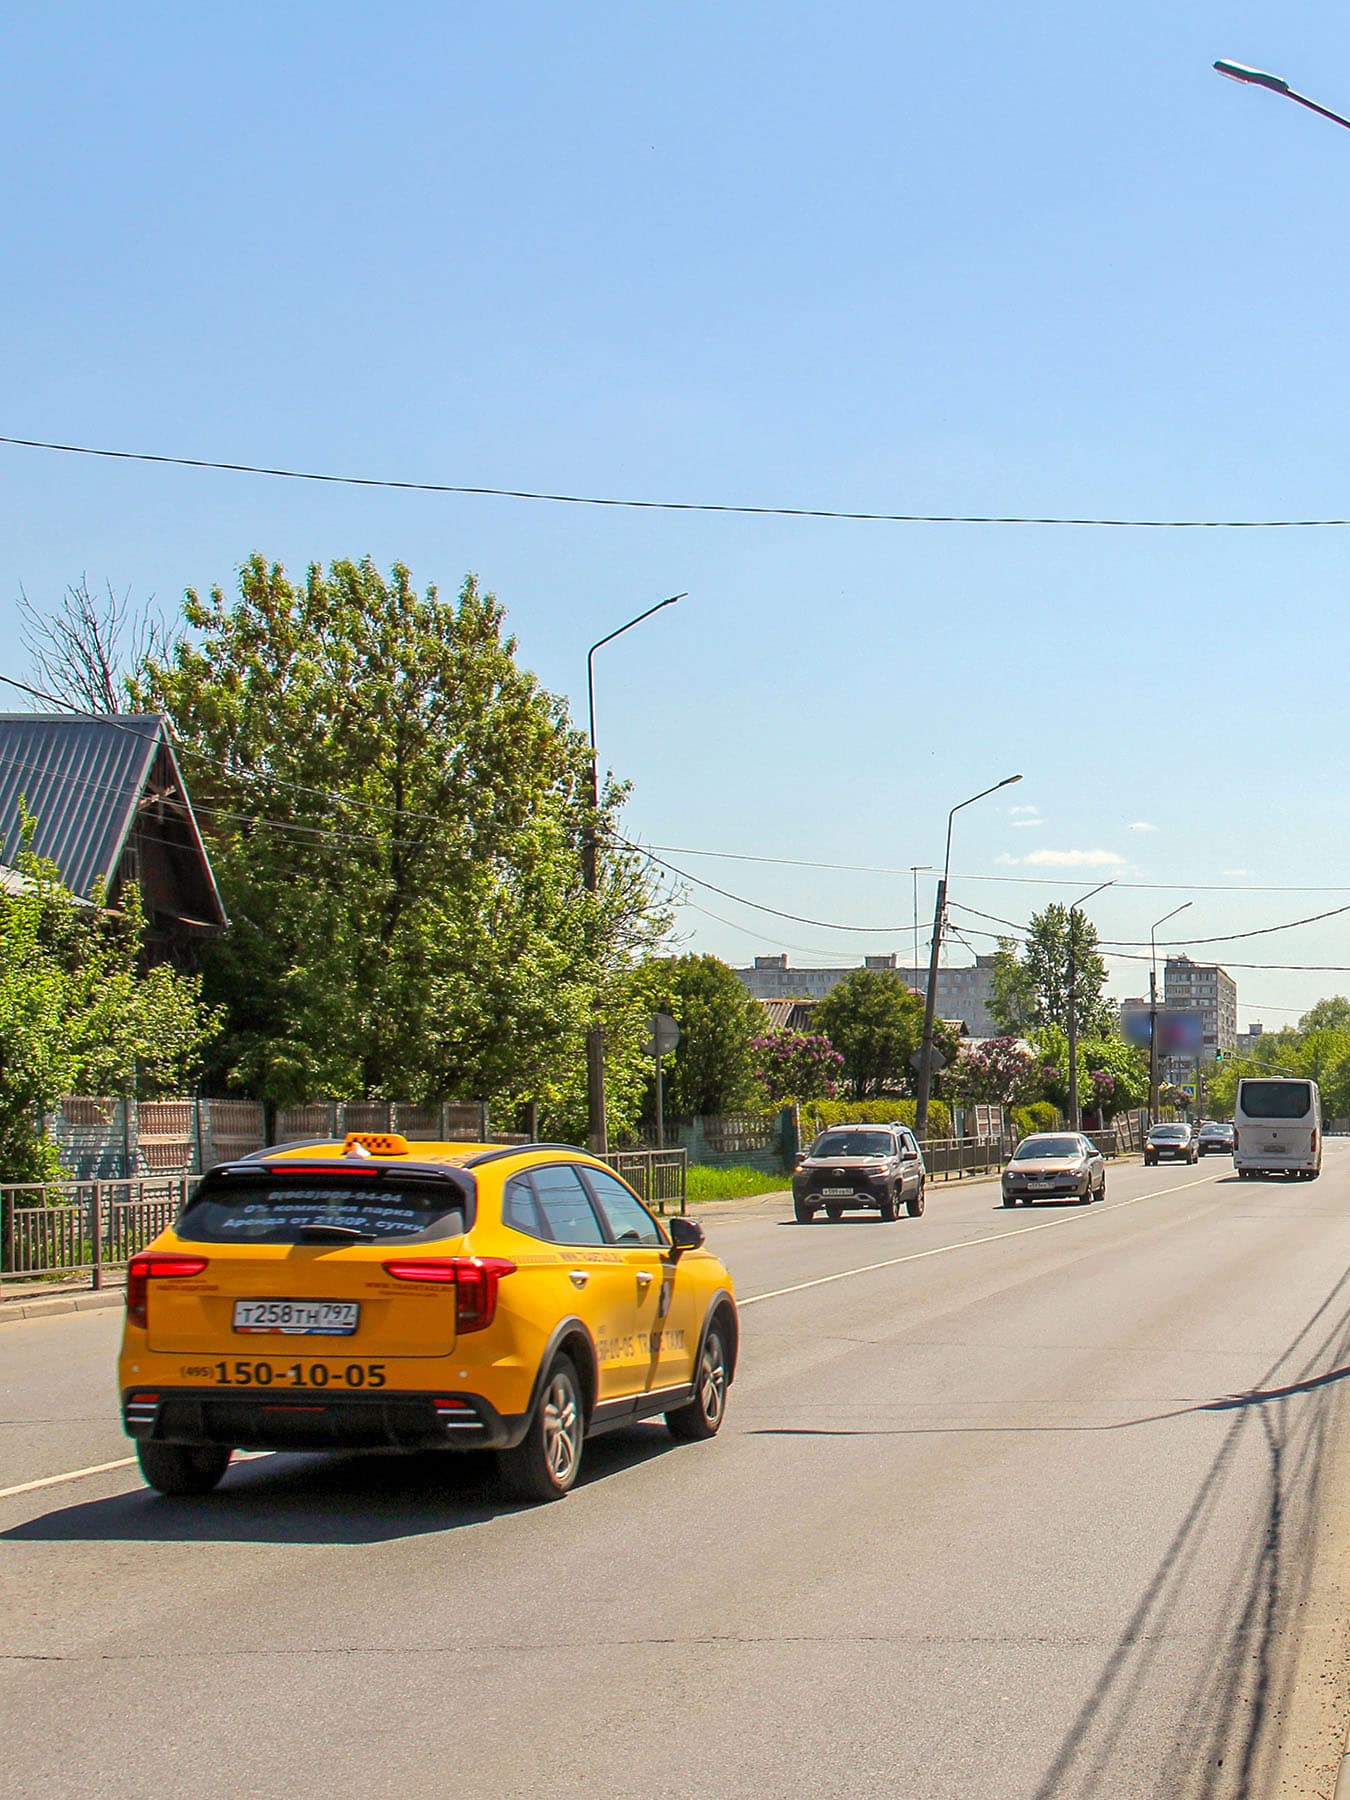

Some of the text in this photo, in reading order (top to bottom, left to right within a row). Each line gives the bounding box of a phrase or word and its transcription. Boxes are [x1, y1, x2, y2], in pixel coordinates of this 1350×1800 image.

[273, 1204, 359, 1213] комиссия
[362, 1205, 415, 1217] парка
[223, 1217, 286, 1228] Аренда
[290, 1217, 309, 1225] от
[321, 1304, 352, 1320] 797
[215, 1361, 386, 1388] 150-10-05
